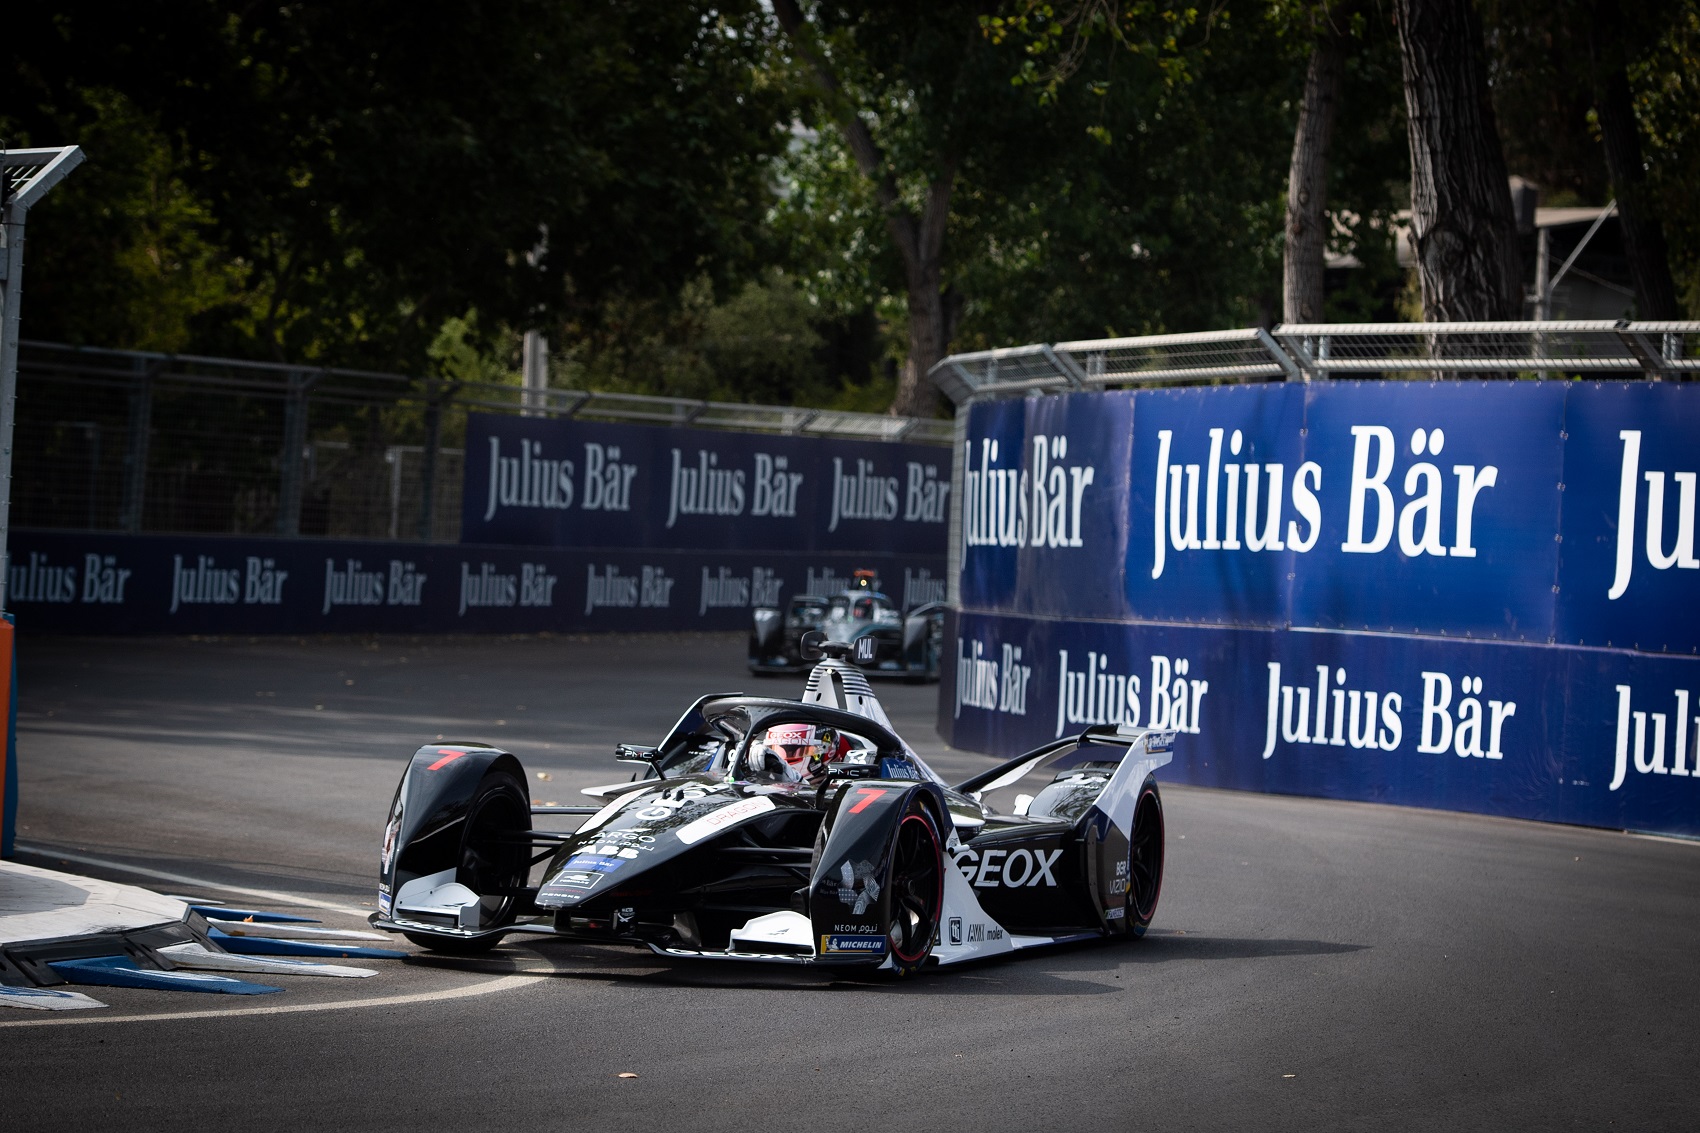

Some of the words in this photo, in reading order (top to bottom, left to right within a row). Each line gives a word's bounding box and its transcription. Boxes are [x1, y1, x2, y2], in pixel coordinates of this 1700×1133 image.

[484, 436, 573, 521] Julius
[582, 442, 637, 511] Bär
[666, 448, 745, 528] Julius
[751, 452, 803, 517] Bär
[829, 457, 898, 532] Julius
[904, 461, 949, 522] Bär
[961, 438, 1028, 571] Julius
[1031, 434, 1095, 548] Bär
[1151, 428, 1322, 580] Julius
[1341, 425, 1498, 558] Bär
[82, 553, 131, 603] Bär
[170, 554, 240, 614] Julius
[244, 555, 288, 604] Bär
[322, 558, 384, 615] Julius
[387, 560, 427, 606] Bär
[458, 562, 517, 616] Julius
[520, 563, 557, 607] Bär
[584, 563, 639, 615] Julius
[640, 565, 674, 607] Bär
[700, 566, 749, 616] Julius
[751, 567, 784, 607] Bär
[858, 638, 872, 659] MUL
[954, 637, 998, 719] Julius
[999, 643, 1031, 715] Bär
[1055, 650, 1141, 738] Julius
[1148, 655, 1209, 734] Bär
[1263, 662, 1402, 759] Julius
[1417, 671, 1516, 760] Bär
[427, 750, 466, 771] 7
[625, 750, 653, 759] PMC
[828, 768, 859, 777] PMC
[848, 788, 888, 814] 7
[570, 844, 640, 859] ABB
[953, 848, 1064, 888] GEOX
[834, 924, 857, 932] NEOM
[840, 941, 882, 949] MICHELIN
